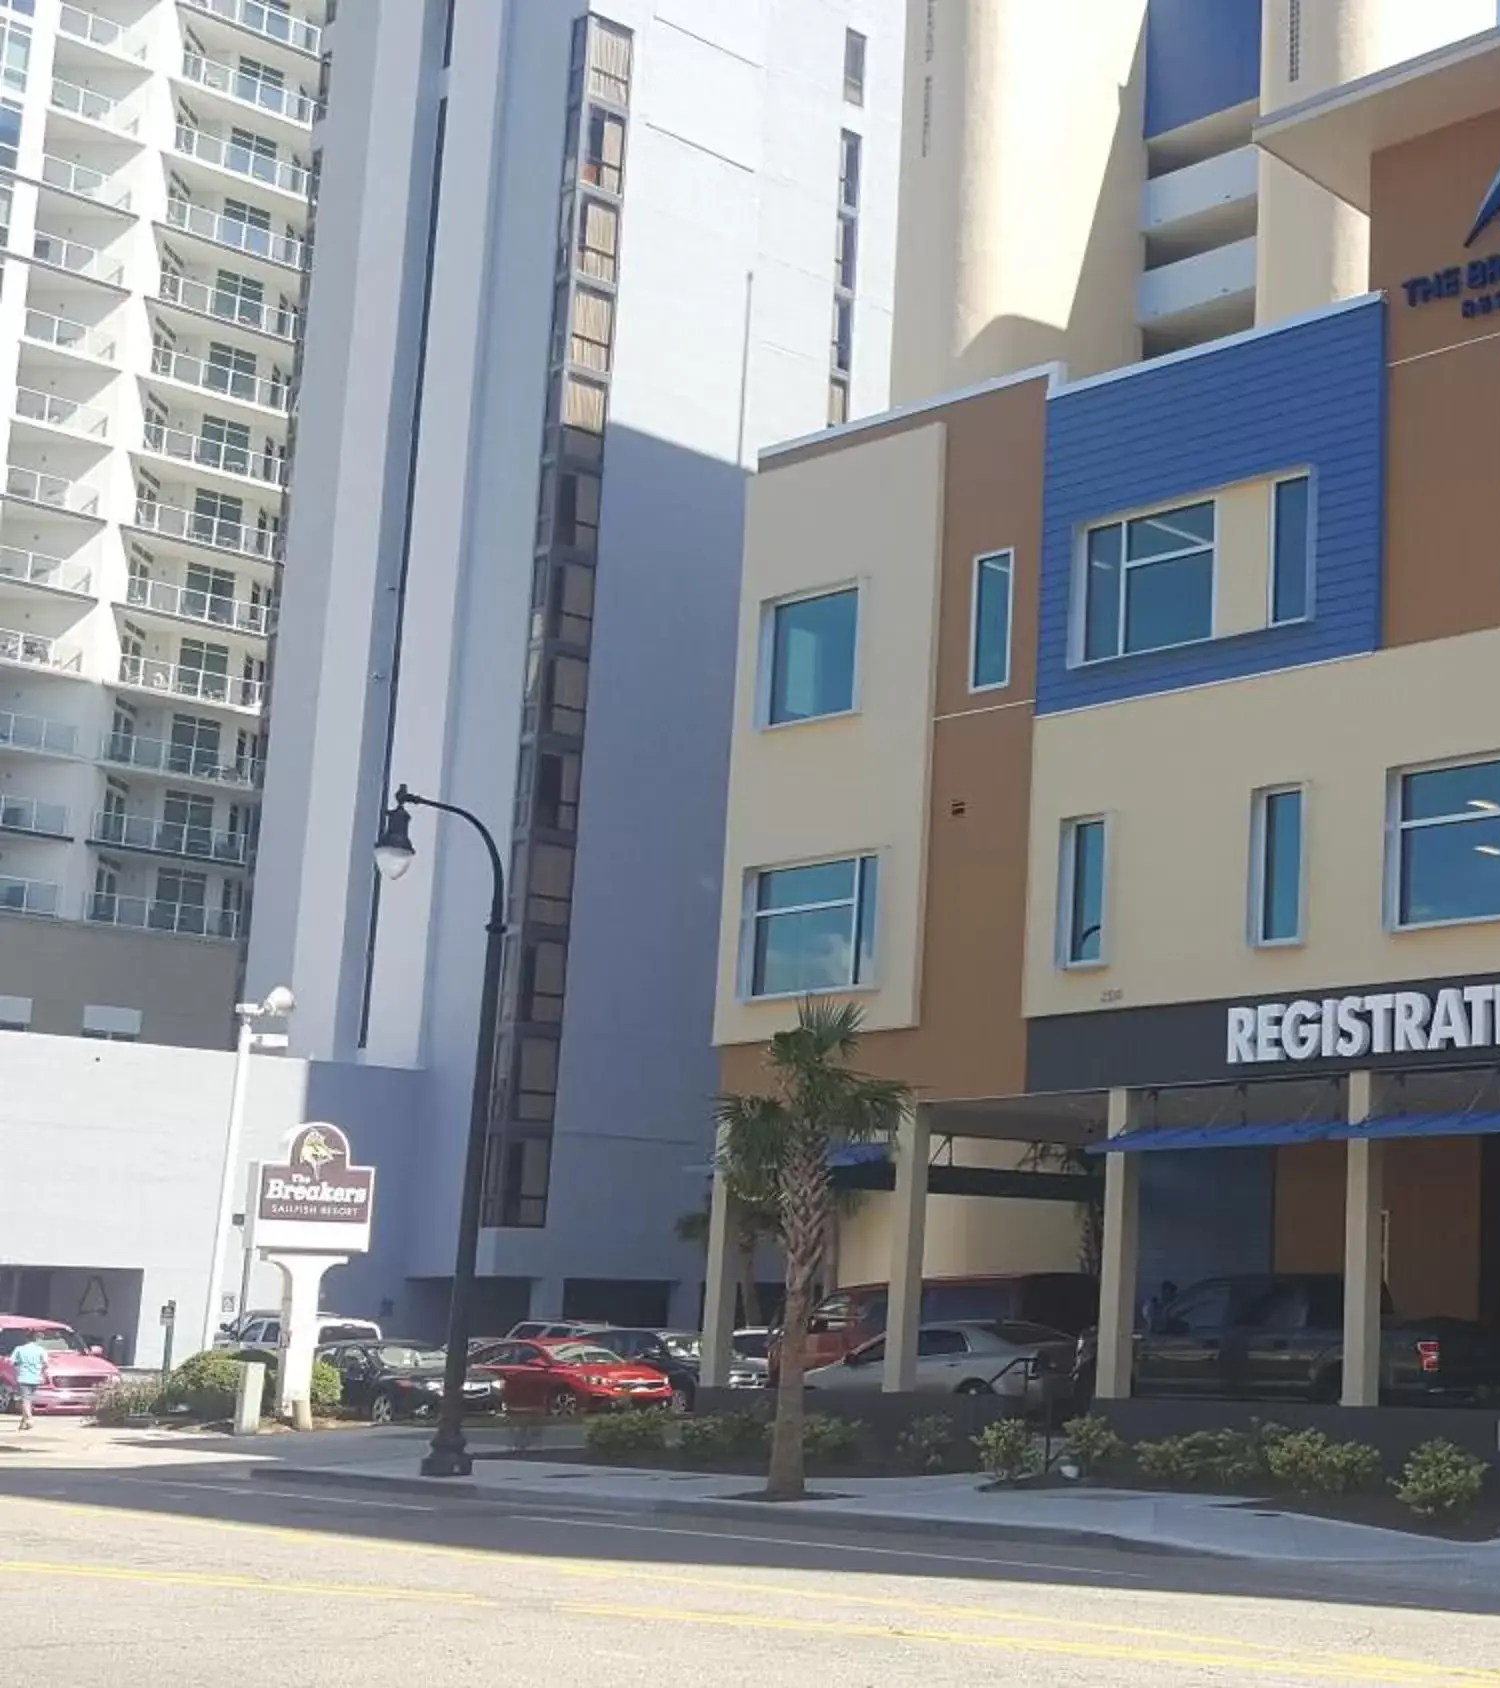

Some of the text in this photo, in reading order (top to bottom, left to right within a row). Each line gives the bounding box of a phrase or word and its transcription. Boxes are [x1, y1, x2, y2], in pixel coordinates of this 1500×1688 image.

[1402, 267, 1461, 306] THE
[264, 1178, 367, 1203] Breakers
[292, 1173, 311, 1184] The
